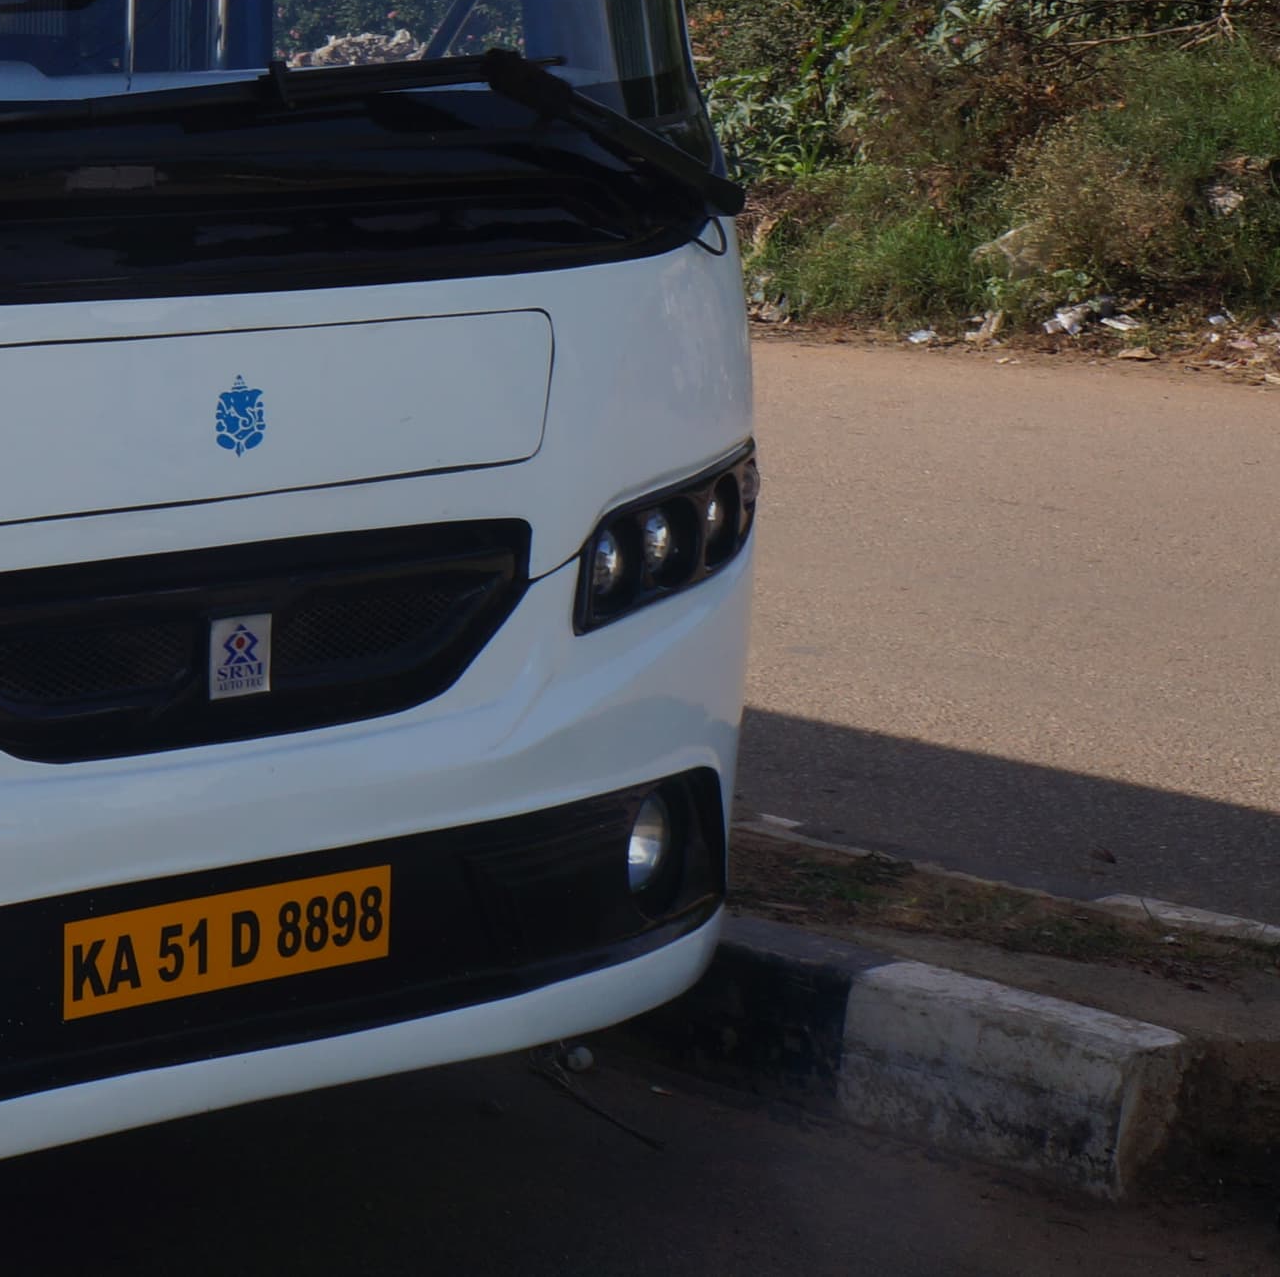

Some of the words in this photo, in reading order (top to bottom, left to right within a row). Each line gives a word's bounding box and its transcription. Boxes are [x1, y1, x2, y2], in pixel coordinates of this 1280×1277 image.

[217, 662, 263, 682] SRM
[72, 934, 142, 1002] KA
[158, 918, 208, 983] 51
[231, 910, 261, 968] D
[277, 886, 383, 958] 8898
